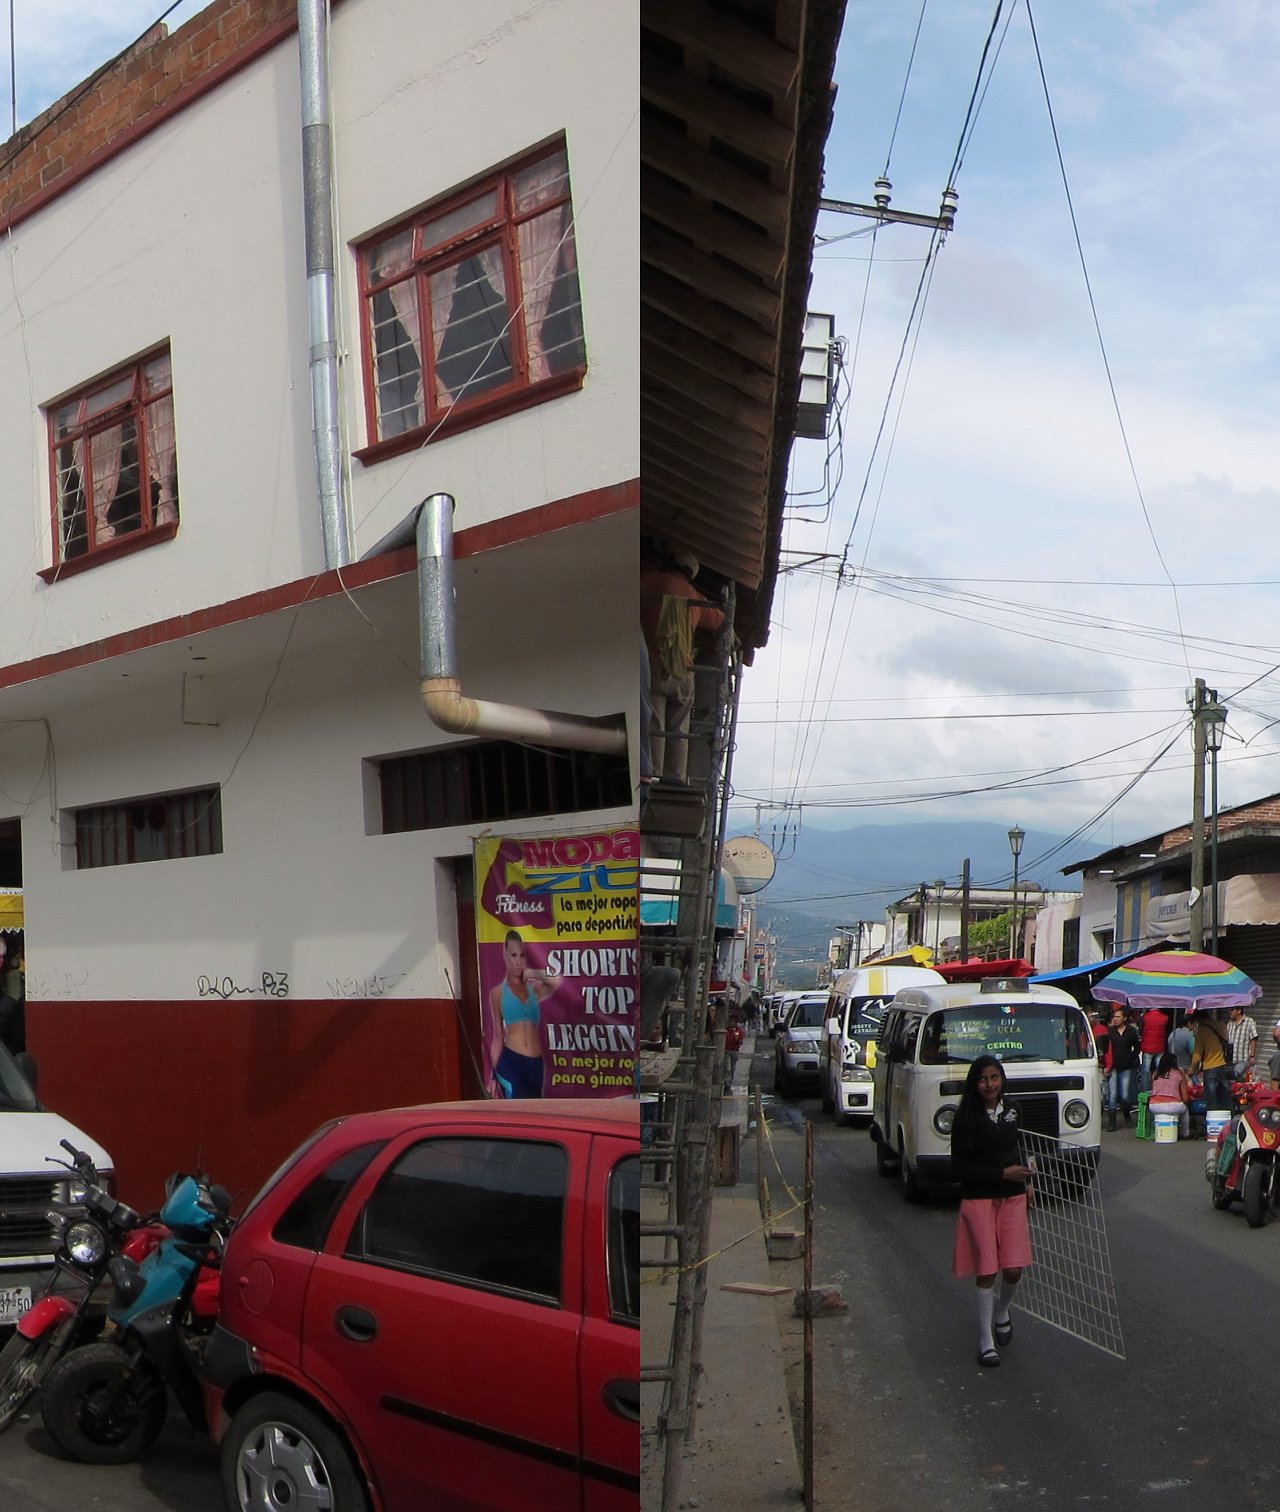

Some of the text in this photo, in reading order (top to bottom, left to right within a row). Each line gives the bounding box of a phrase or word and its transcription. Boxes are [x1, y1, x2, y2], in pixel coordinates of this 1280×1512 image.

[495, 893, 544, 914] Fitness
[560, 894, 637, 914] la mejor ropa
[557, 921, 583, 936] para
[581, 986, 635, 1014] TOP
[986, 1041, 1024, 1050] CENTRO
[553, 1054, 567, 1066] la
[572, 1054, 614, 1072] mejor
[551, 1073, 586, 1086] para
